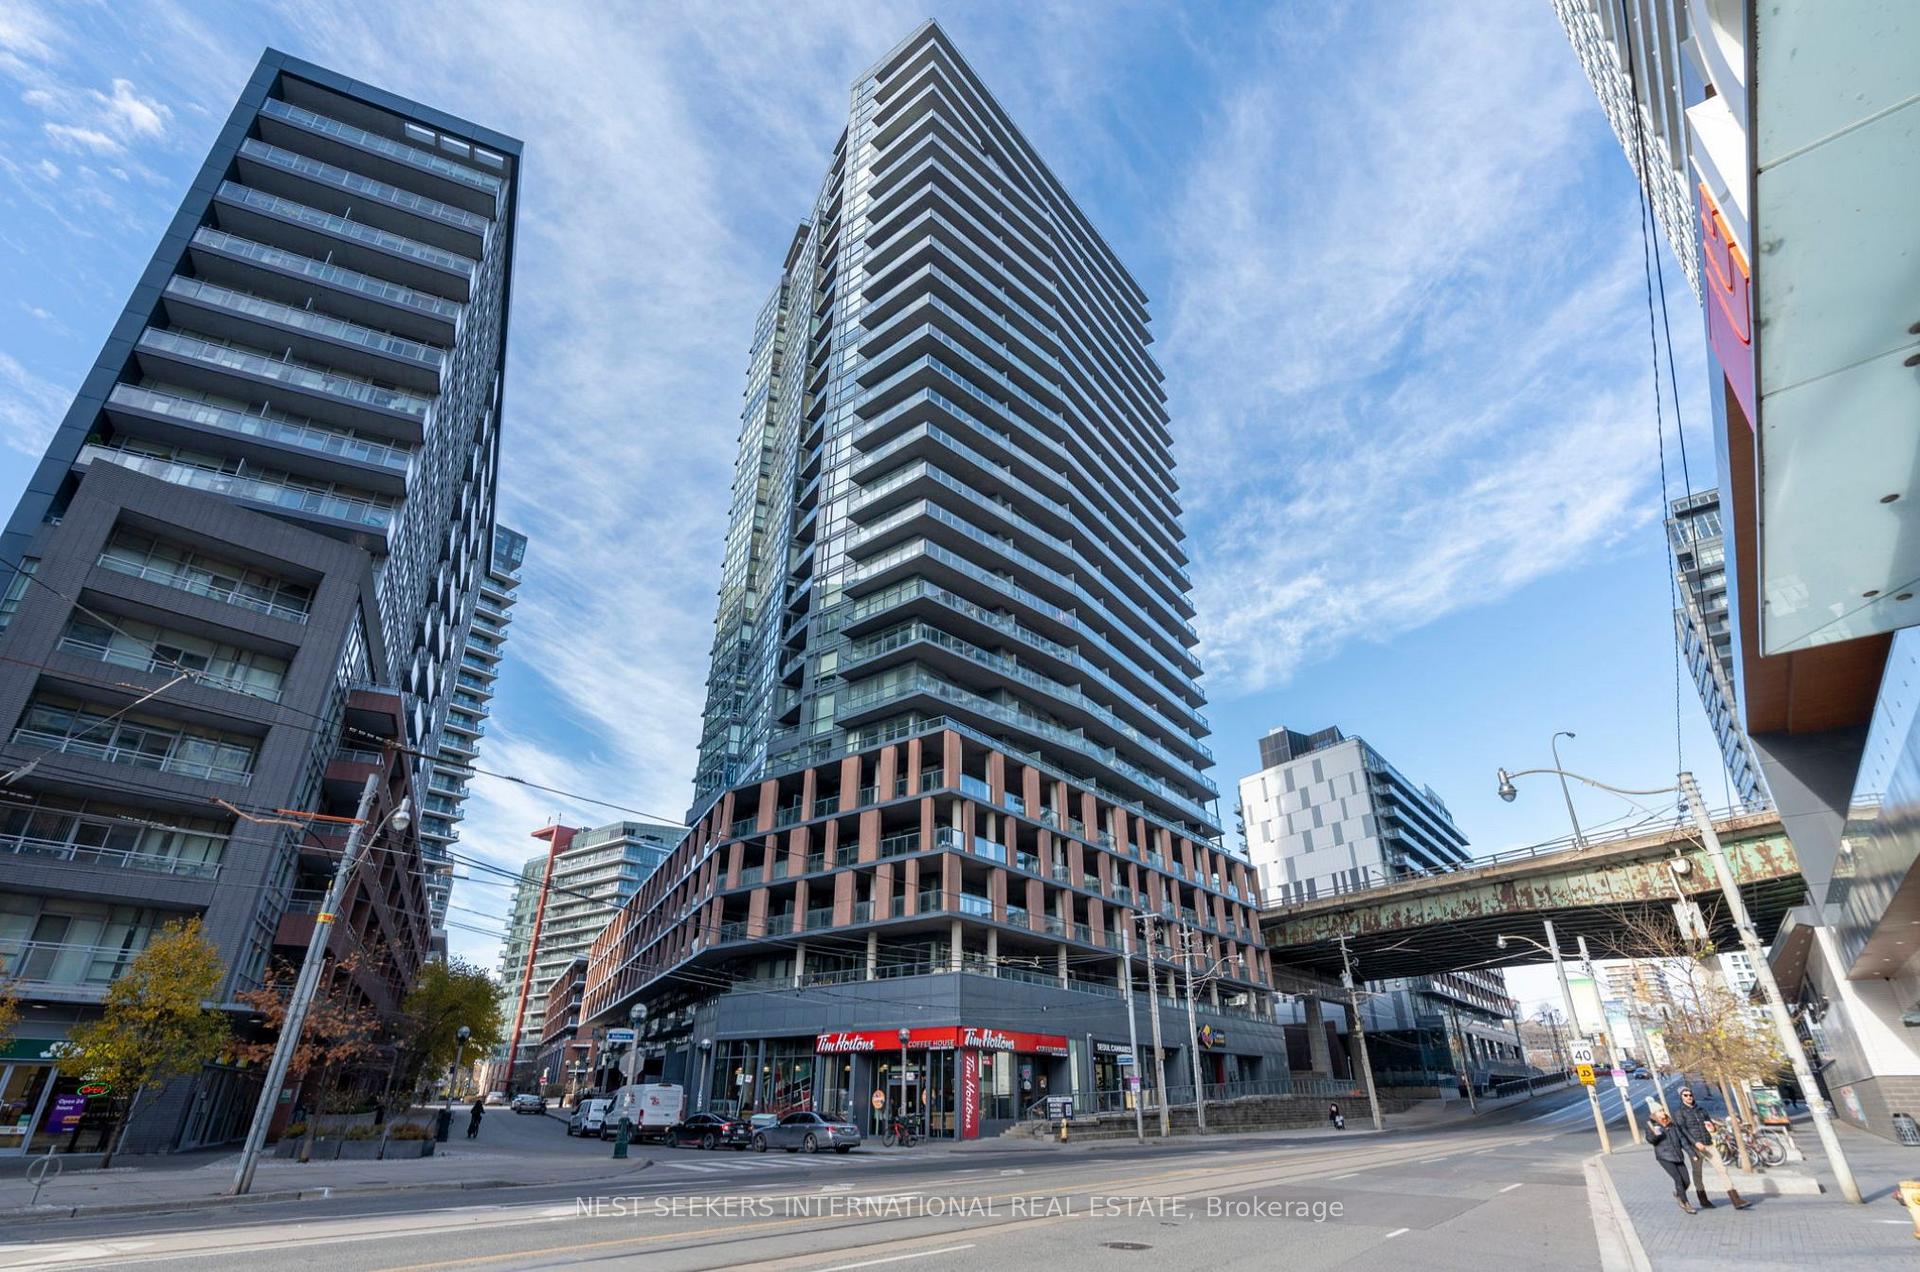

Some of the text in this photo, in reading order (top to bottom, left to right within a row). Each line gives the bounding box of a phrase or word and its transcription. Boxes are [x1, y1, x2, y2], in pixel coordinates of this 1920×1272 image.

[817, 1033, 875, 1052] Tim Hortons
[907, 1041, 931, 1049] COFFEE
[932, 1039, 955, 1048] HOUSE
[964, 1028, 1015, 1050] Tim Hortons
[1097, 1043, 1111, 1052] SEOUL
[1575, 1050, 1592, 1061] 40
[965, 1055, 975, 1129] Tim Hortons
